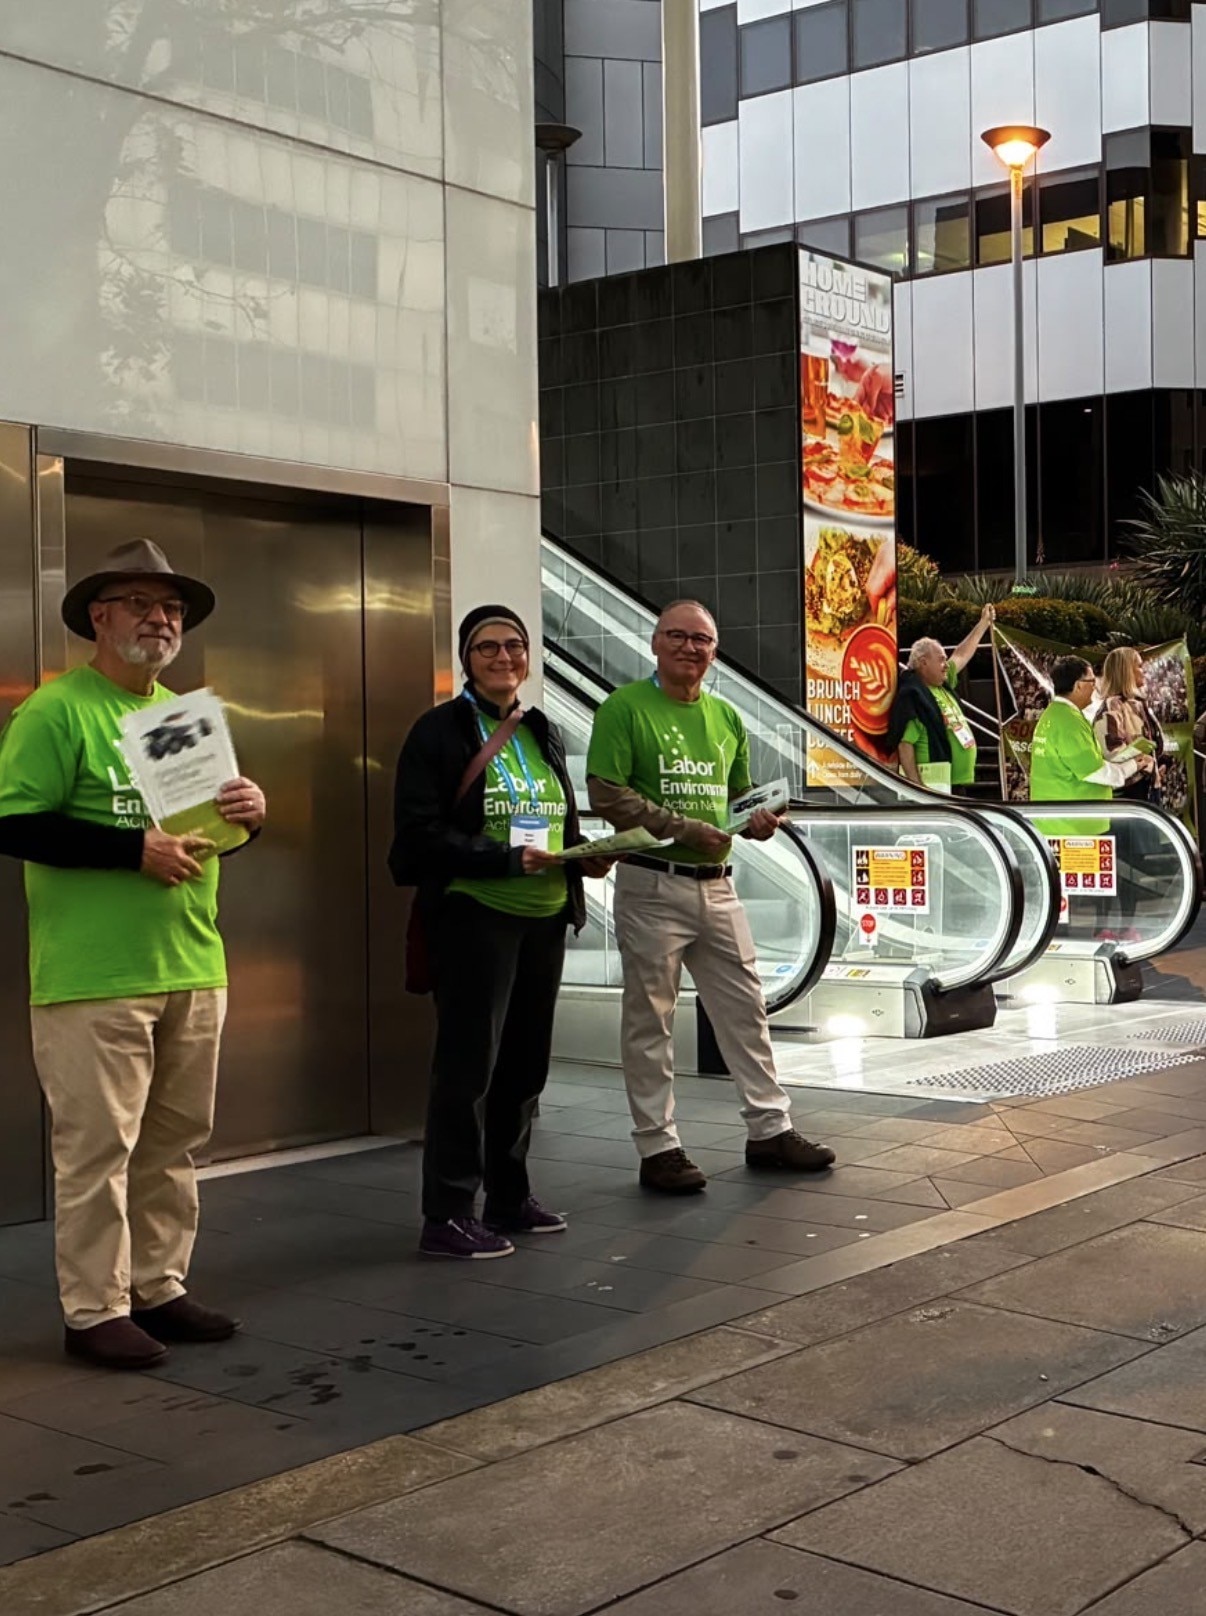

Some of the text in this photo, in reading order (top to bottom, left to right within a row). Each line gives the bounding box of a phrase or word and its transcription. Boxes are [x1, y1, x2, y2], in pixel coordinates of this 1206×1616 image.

[807, 678, 860, 700] BRUNCH
[659, 754, 715, 776] Labor
[663, 798, 698, 811] Action
